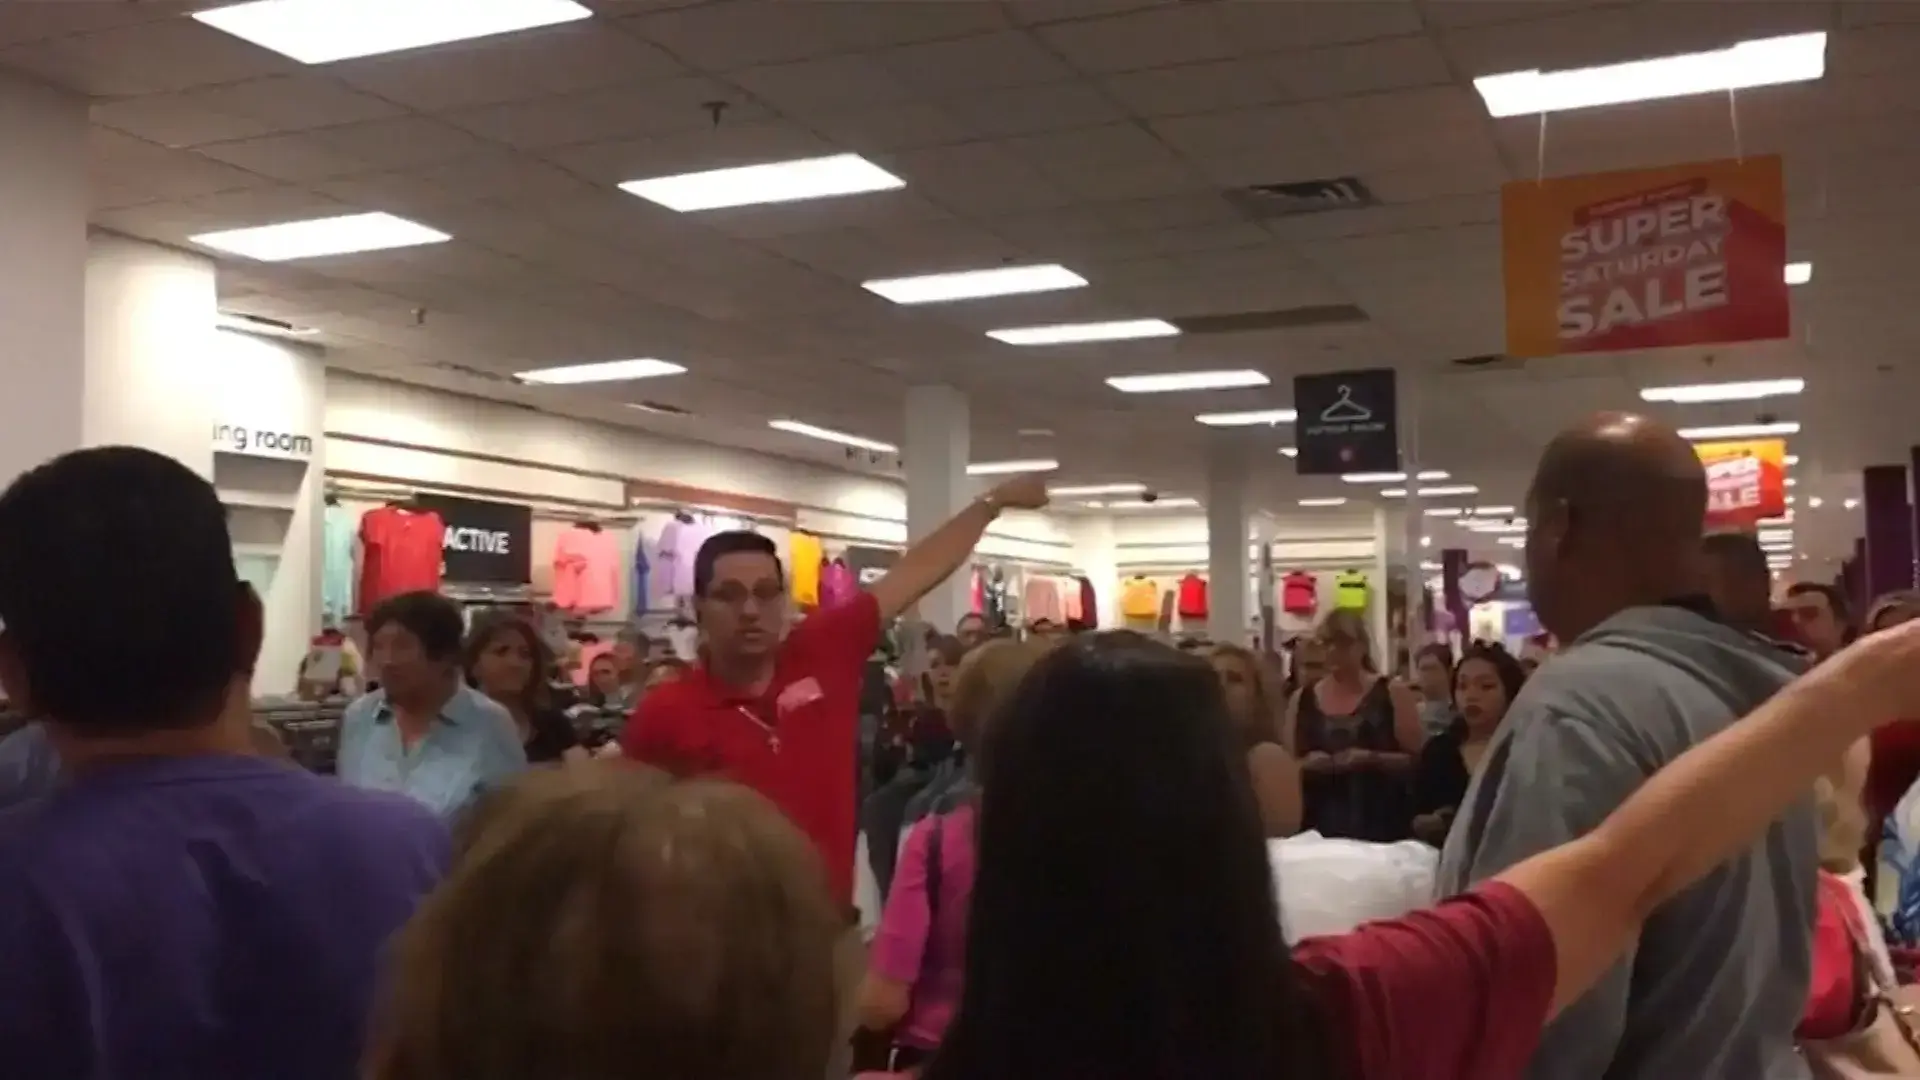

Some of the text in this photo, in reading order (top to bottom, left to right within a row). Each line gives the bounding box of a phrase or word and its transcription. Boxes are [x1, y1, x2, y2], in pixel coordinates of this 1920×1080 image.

[1560, 196, 1730, 262] SUPER
[1561, 237, 1723, 291] SATURDAY
[1557, 265, 1729, 339] SALE
[255, 430, 312, 453] room
[442, 526, 510, 555] ACTIVE
